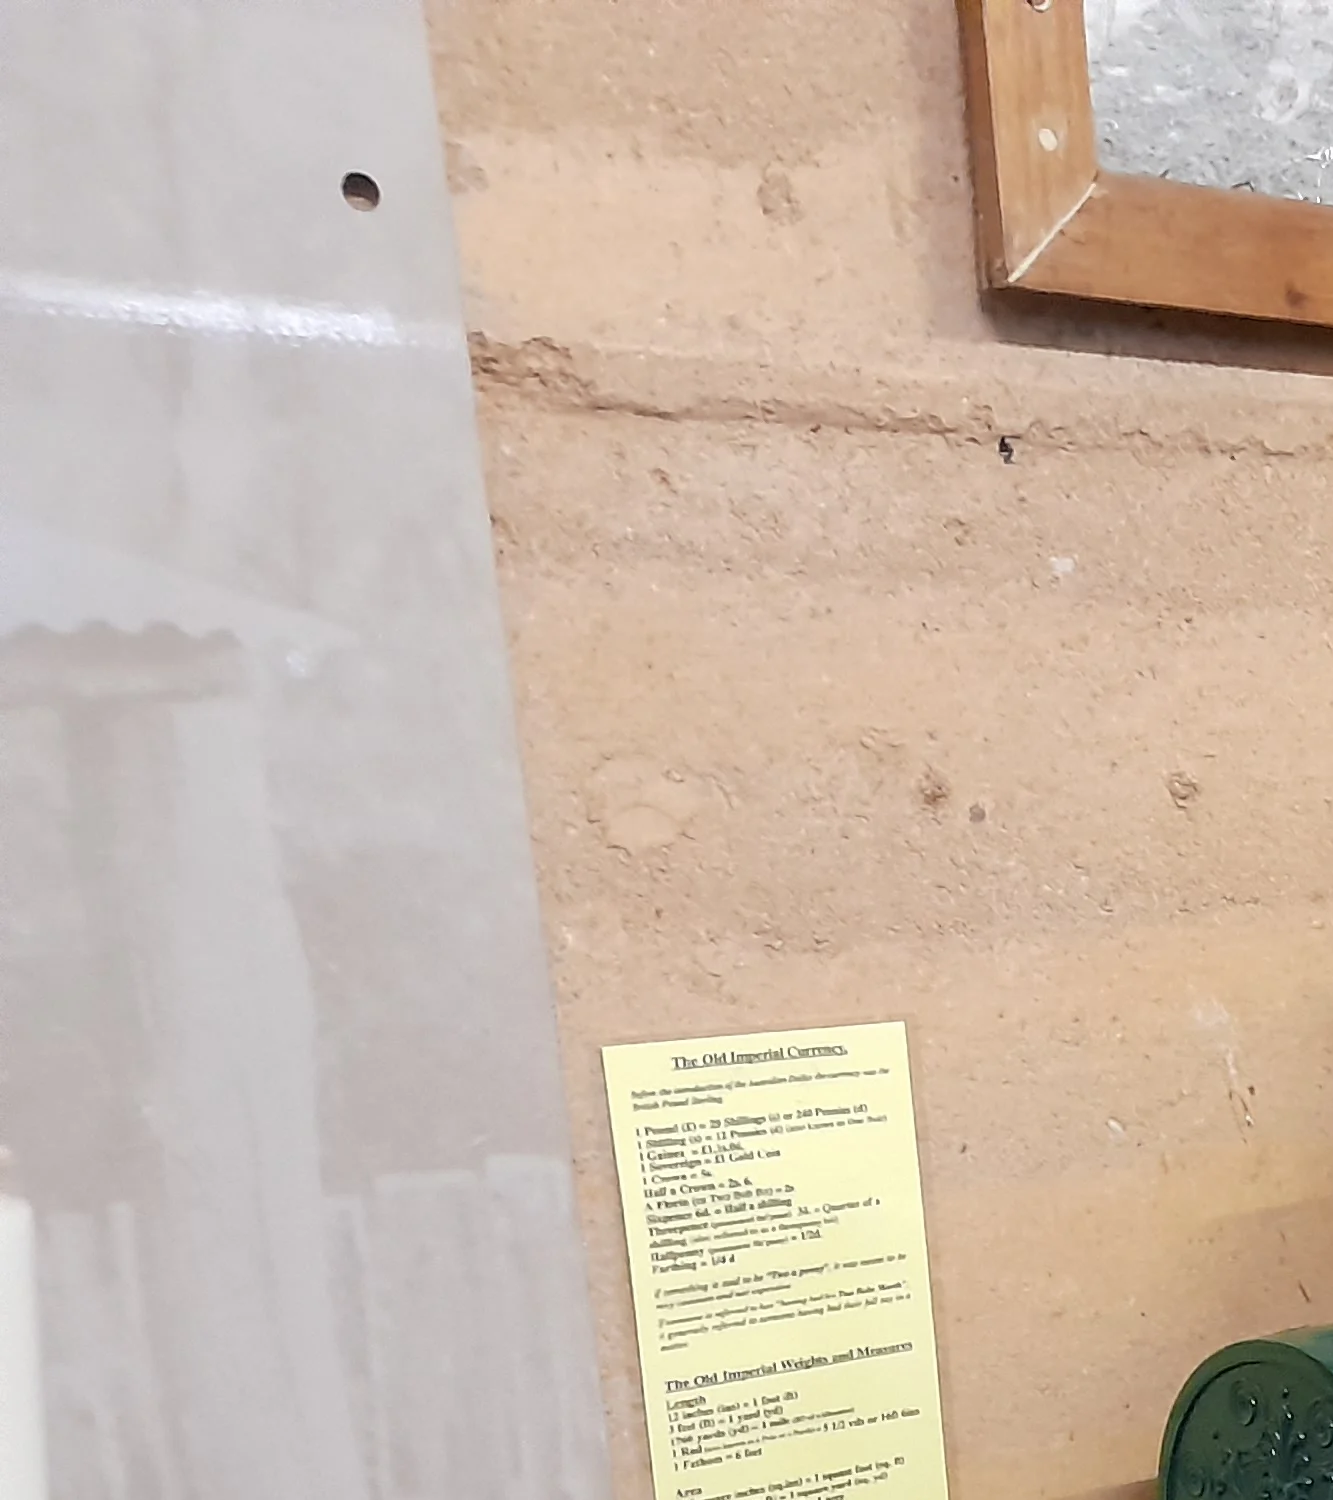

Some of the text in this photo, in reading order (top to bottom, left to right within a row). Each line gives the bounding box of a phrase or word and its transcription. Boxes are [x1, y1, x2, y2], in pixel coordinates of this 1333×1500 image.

[671, 1056, 699, 1070] The
[702, 1052, 728, 1066] Old
[730, 1047, 784, 1064] Imperial
[665, 1379, 690, 1393] The
[693, 1372, 718, 1388] Old
[722, 1362, 777, 1383] Imperial
